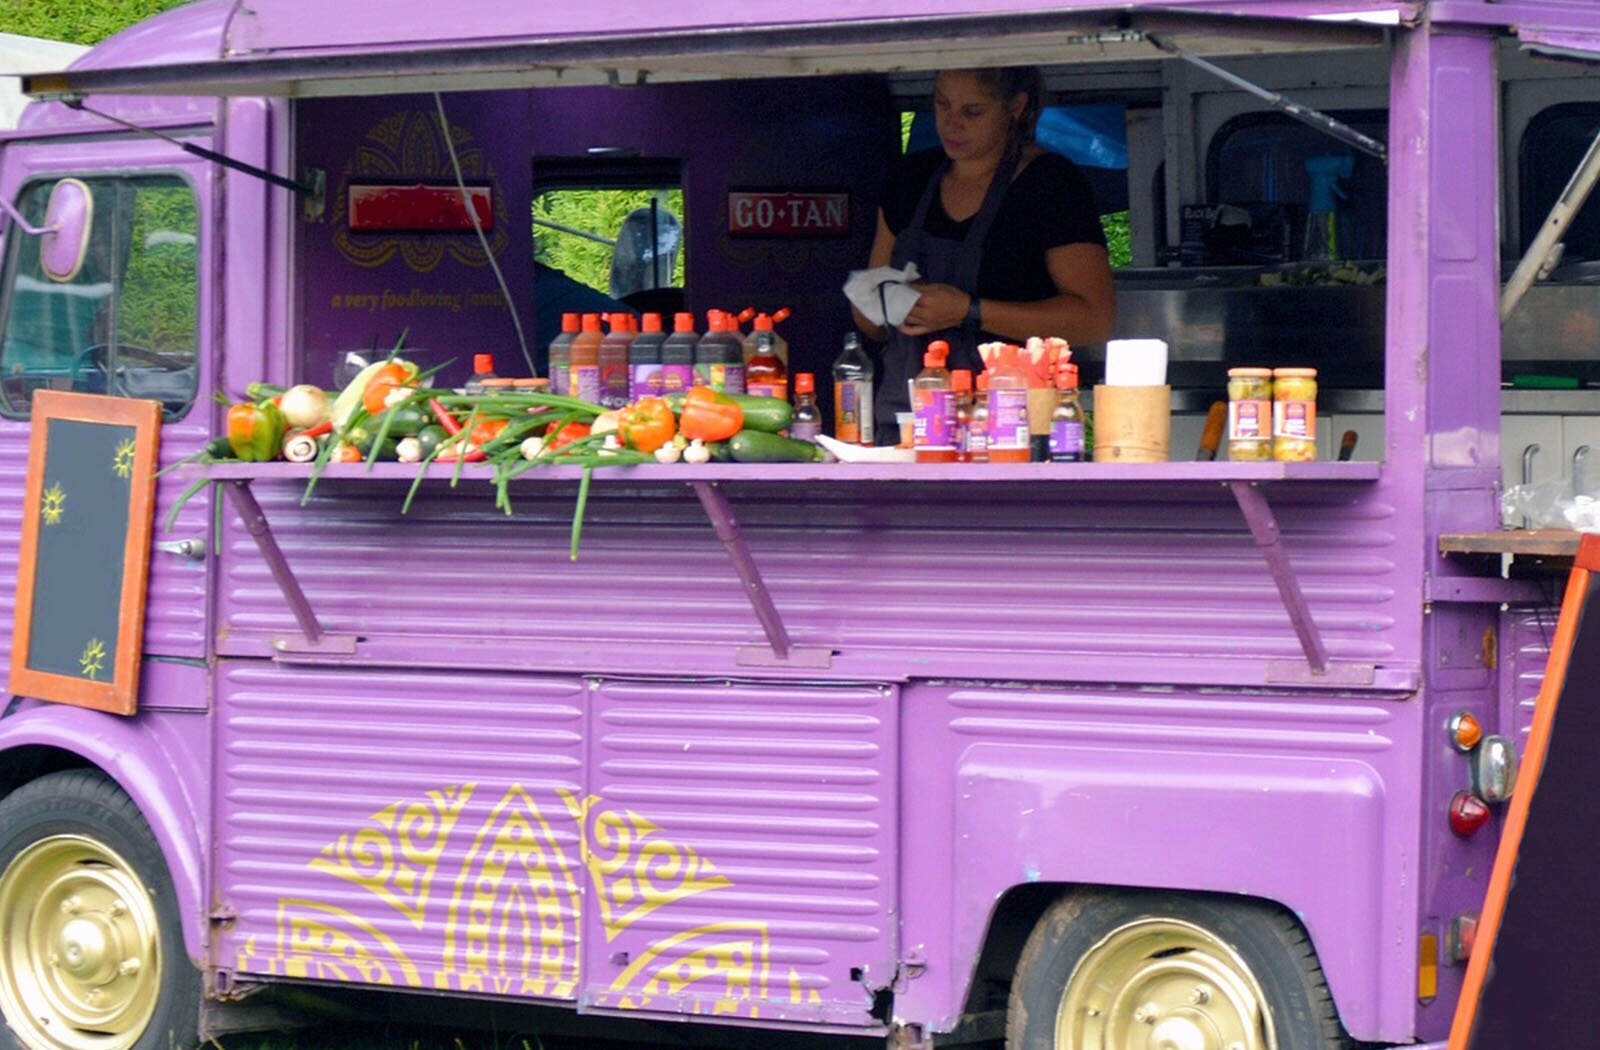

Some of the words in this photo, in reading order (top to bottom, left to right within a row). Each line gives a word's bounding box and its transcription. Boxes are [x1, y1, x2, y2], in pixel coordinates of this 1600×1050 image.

[330, 295, 342, 308] a
[345, 294, 378, 313] very
[380, 289, 460, 313] foodloving
